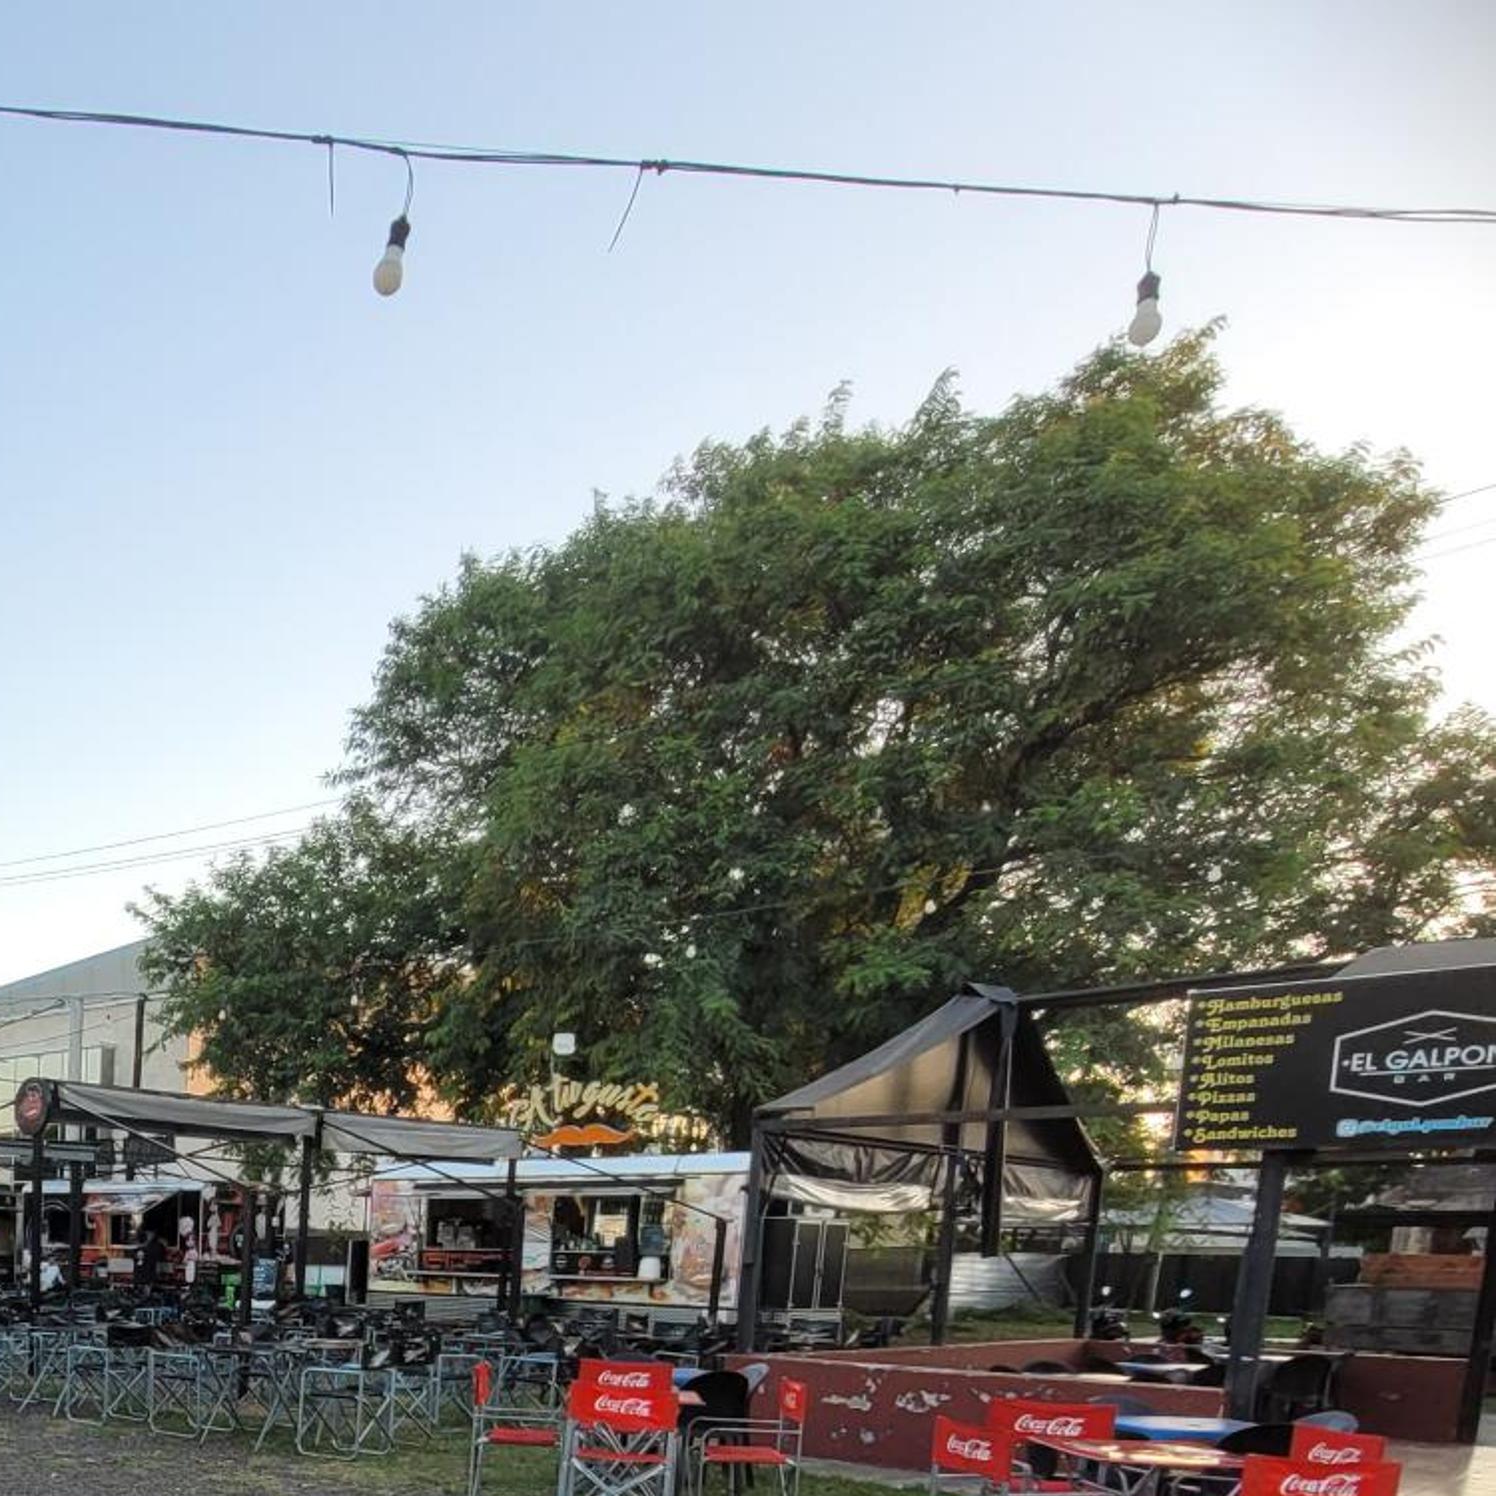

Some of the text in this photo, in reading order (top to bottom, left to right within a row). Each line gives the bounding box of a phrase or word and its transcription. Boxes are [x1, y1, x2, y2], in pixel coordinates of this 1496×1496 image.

[1207, 991, 1344, 1016] Hamburguesas
[1206, 1012, 1312, 1032] Empanadas
[1202, 1033, 1296, 1053] Milanesas
[1201, 1052, 1275, 1070] Lomitos
[1350, 1052, 1377, 1072] EL
[1192, 1125, 1298, 1144] Sandwiches
